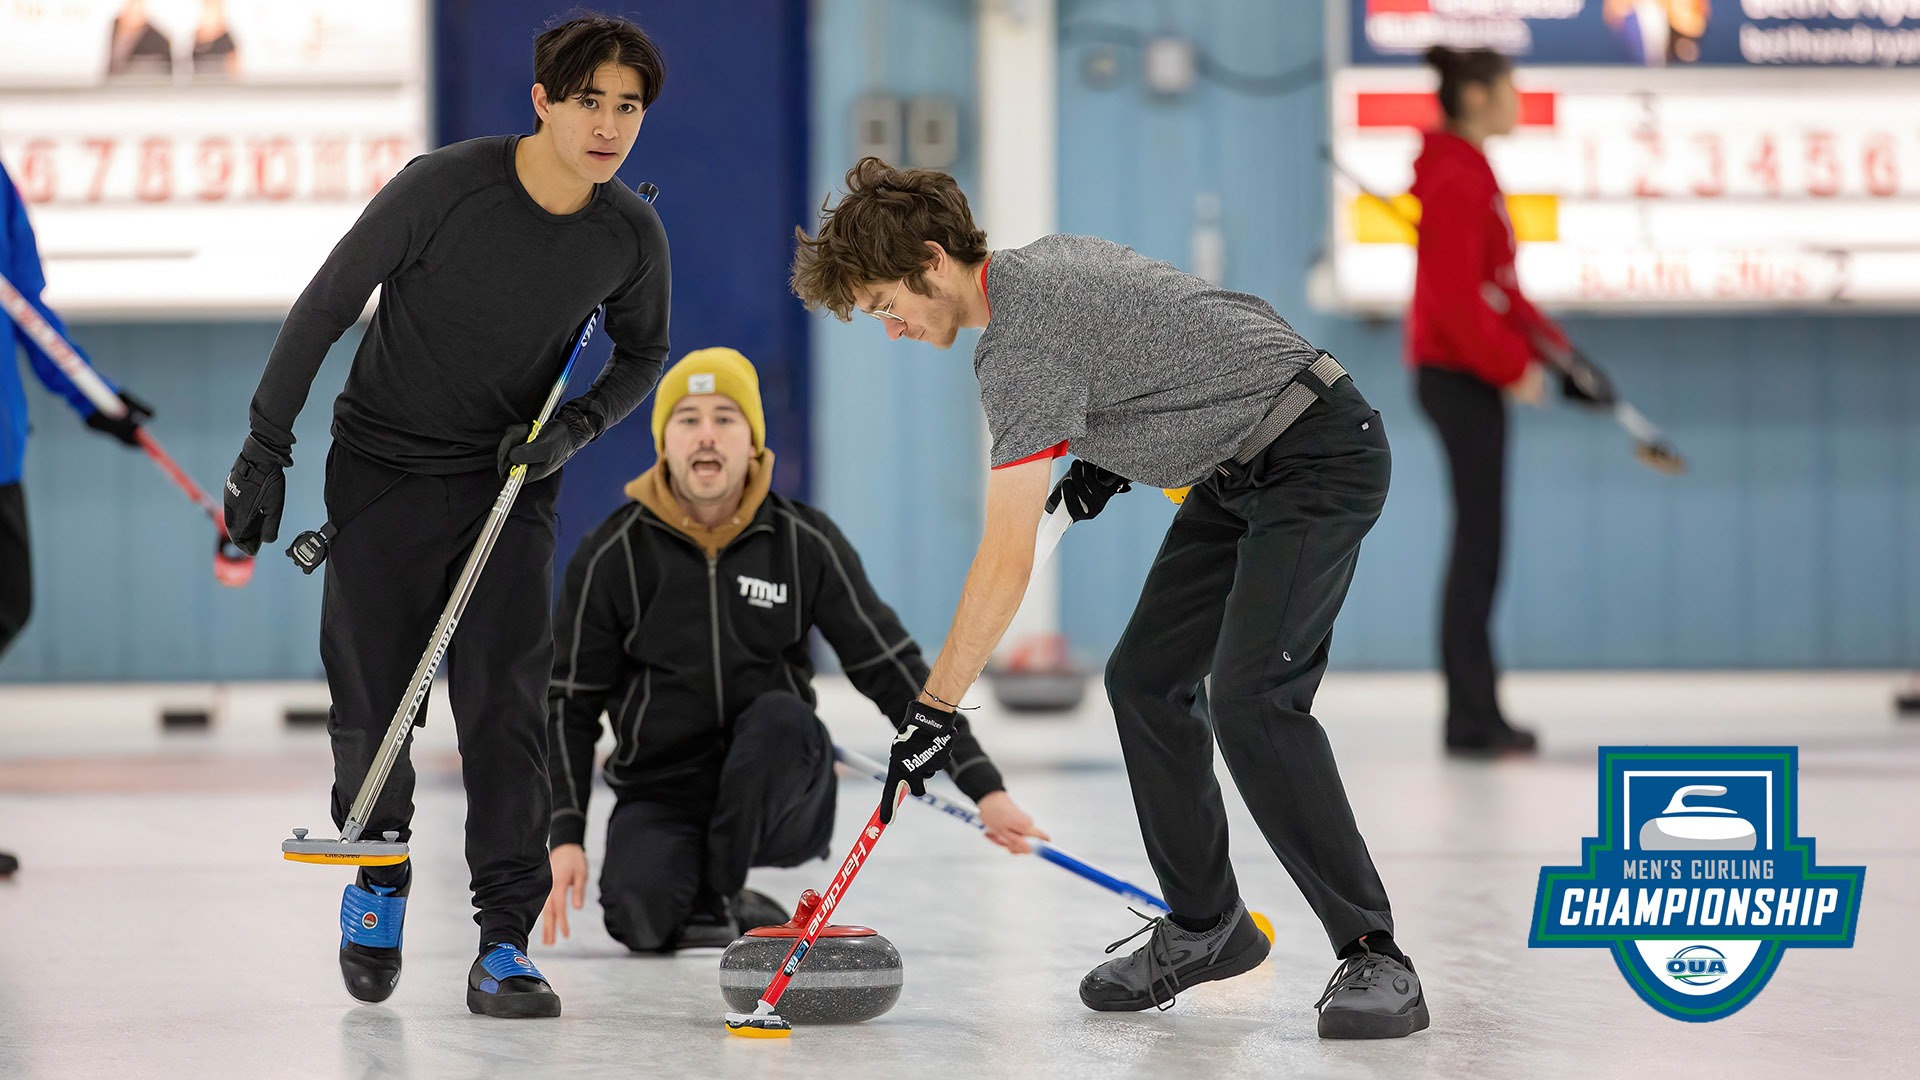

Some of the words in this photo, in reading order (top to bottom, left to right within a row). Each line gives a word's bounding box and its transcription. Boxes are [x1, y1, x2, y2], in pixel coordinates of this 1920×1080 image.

[21, 136, 58, 204] 6
[80, 137, 117, 203] 7
[136, 136, 174, 203] 8
[196, 136, 232, 203] 9
[246, 136, 298, 203] 10
[1689, 130, 1727, 197] 3
[1746, 129, 1781, 197] 4
[1804, 128, 1841, 198] 5
[1862, 129, 1900, 198] 6
[737, 575, 787, 604] TMU
[901, 734, 952, 773] BalancePlus
[807, 840, 867, 937] Hardline
